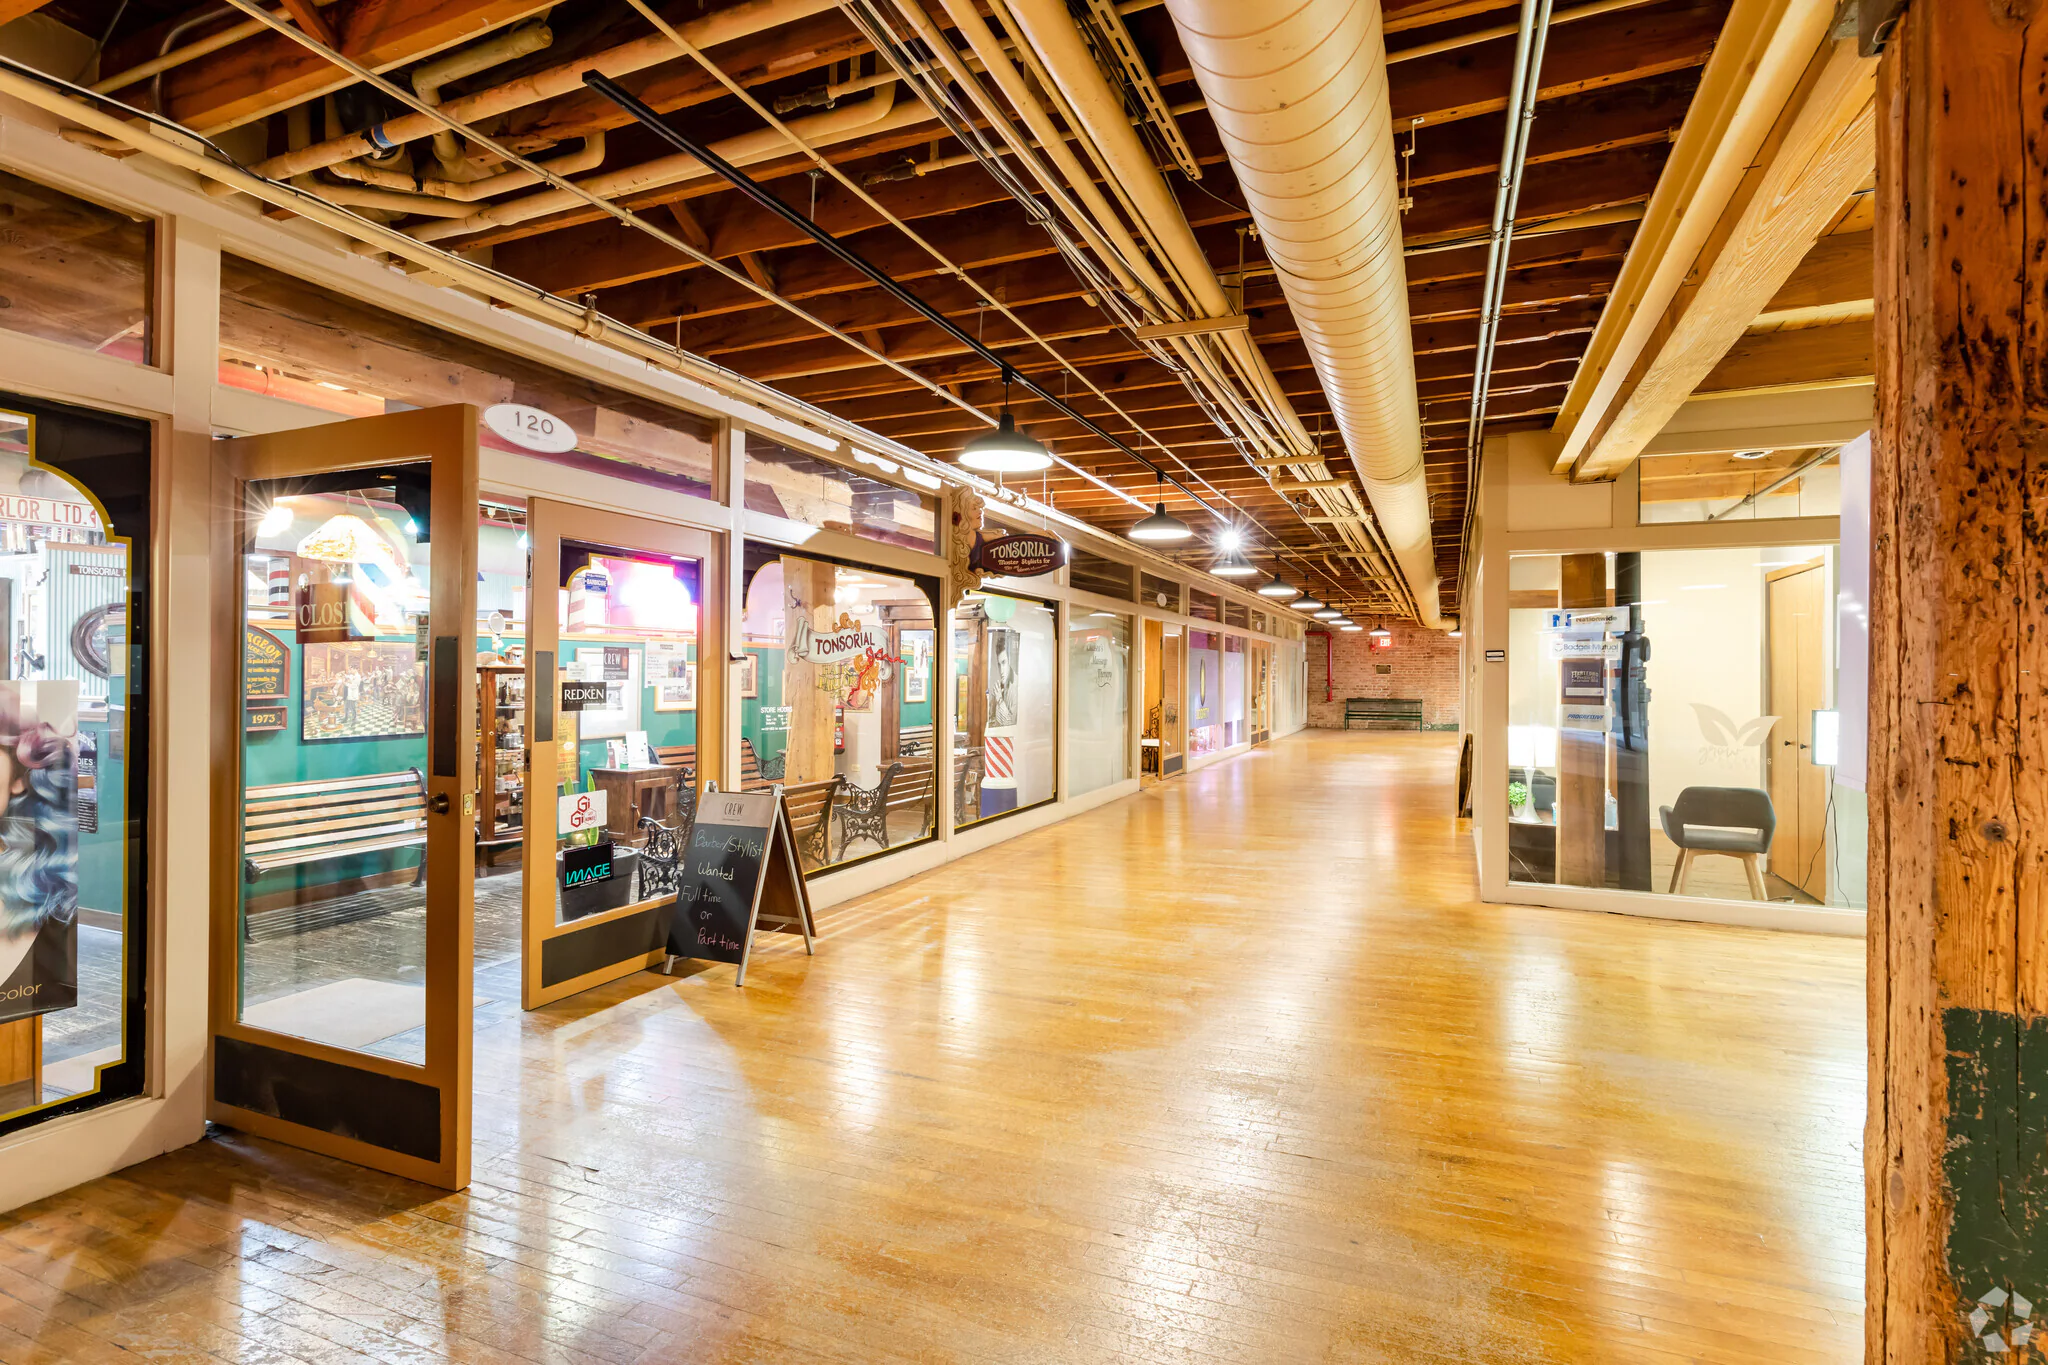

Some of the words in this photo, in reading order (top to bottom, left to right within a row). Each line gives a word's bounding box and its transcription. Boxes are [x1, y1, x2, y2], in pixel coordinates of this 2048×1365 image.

[515, 410, 554, 435] 120
[52, 502, 88, 525] LTD.
[989, 541, 1056, 559] TONSORIAL
[78, 565, 121, 577] TONSORIAL
[300, 601, 351, 627] CLOS
[815, 632, 876, 655] TONSORIAL
[1592, 643, 1619, 651] Mutual
[604, 653, 621, 665] CREW
[564, 688, 605, 701] REDKEN
[252, 714, 276, 724] 1973
[724, 802, 744, 816] CREW
[566, 862, 610, 884] IMAGE
[697, 862, 734, 881] Wanted
[681, 885, 700, 902] Full
[702, 889, 722, 903] time
[700, 911, 712, 920] or
[697, 927, 716, 946] Part
[721, 933, 740, 950] time
